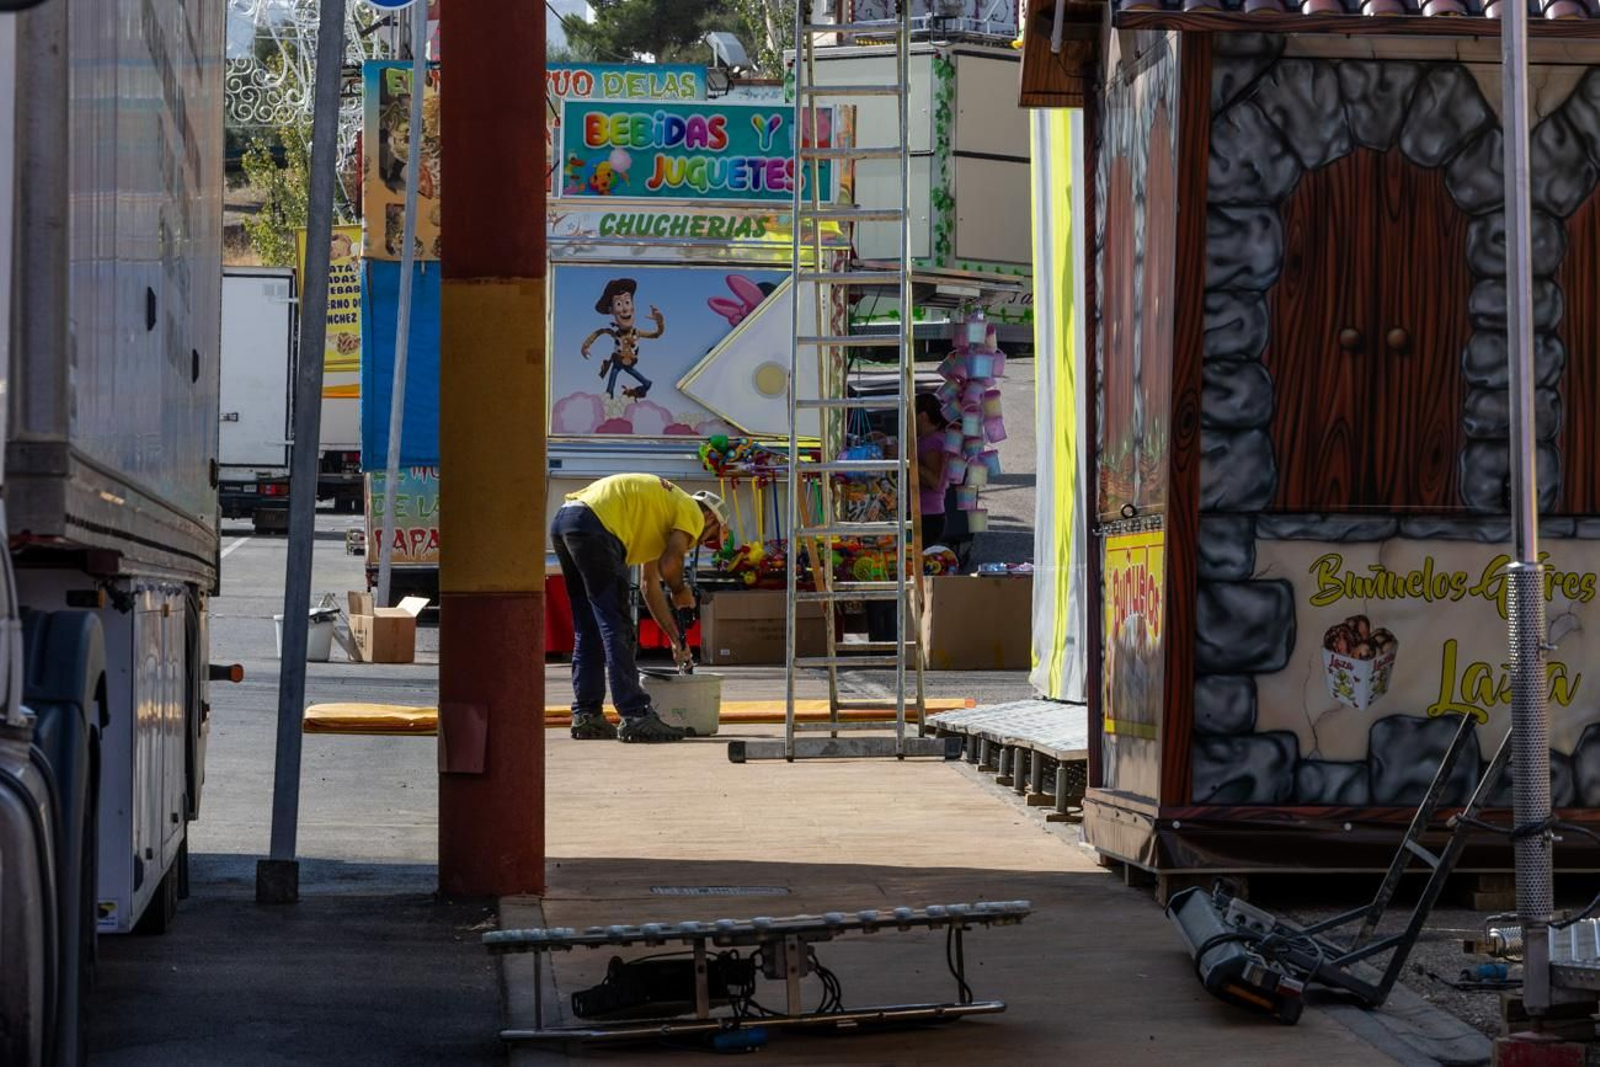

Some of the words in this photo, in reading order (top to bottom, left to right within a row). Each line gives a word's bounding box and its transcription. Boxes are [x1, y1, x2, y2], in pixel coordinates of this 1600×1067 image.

[751, 113, 783, 152] Y
[646, 153, 806, 193] JUGUETES
[599, 212, 770, 238] CHUCHERIAS
[327, 298, 350, 310] RNO
[1309, 553, 1468, 607] Buñuelos
[1427, 638, 1582, 726] Laa
